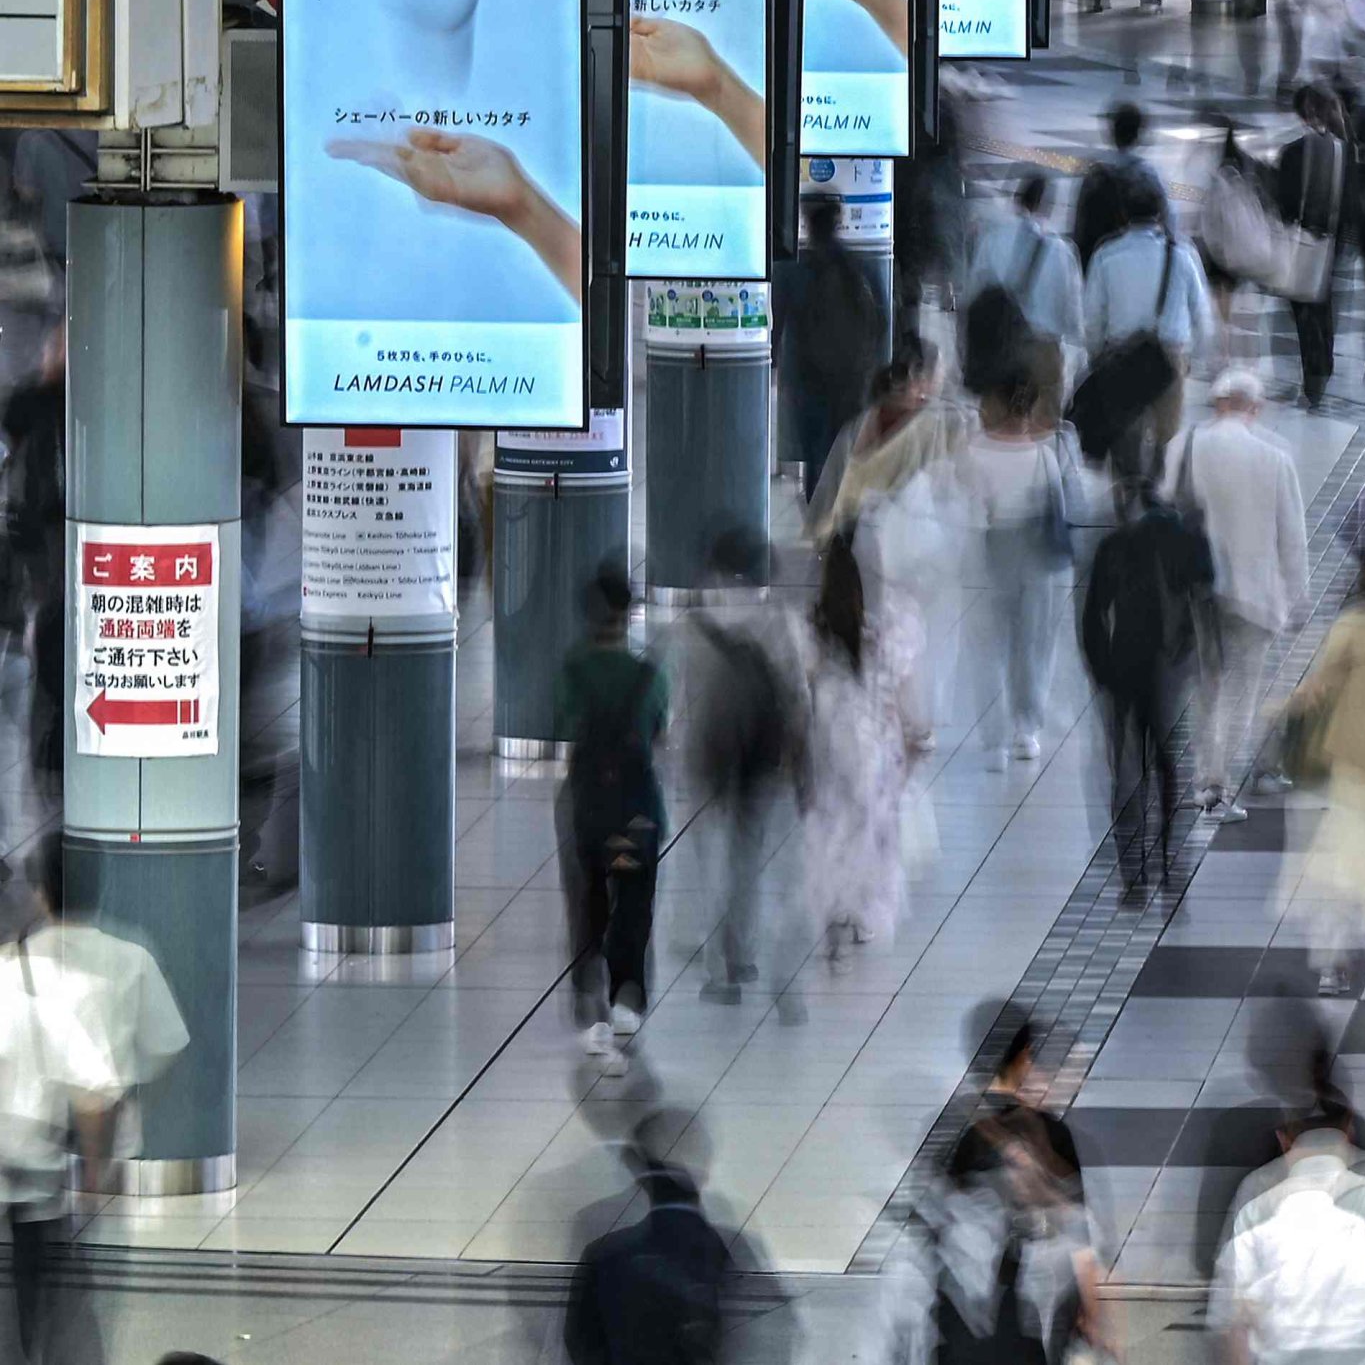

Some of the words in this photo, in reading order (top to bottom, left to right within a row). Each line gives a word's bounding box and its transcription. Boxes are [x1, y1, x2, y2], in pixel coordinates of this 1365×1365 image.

[976, 21, 991, 33] IN
[334, 108, 531, 127] シェーバーの新しいカタチ
[803, 114, 849, 130] PALM
[853, 115, 871, 130] IN
[647, 233, 701, 249] PALM
[703, 233, 723, 250] IN
[377, 349, 492, 363] 5枚刃を、手のひらに。
[334, 374, 443, 392] LAMDASH
[450, 376, 507, 394] PALM
[512, 376, 535, 395] IN
[93, 554, 197, 581] ご案内
[91, 594, 201, 614] 朝の混雑時は
[99, 618, 191, 639] 通路両端を
[93, 647, 198, 667] ご通行下さい
[85, 672, 200, 689] ご協力お願いします
